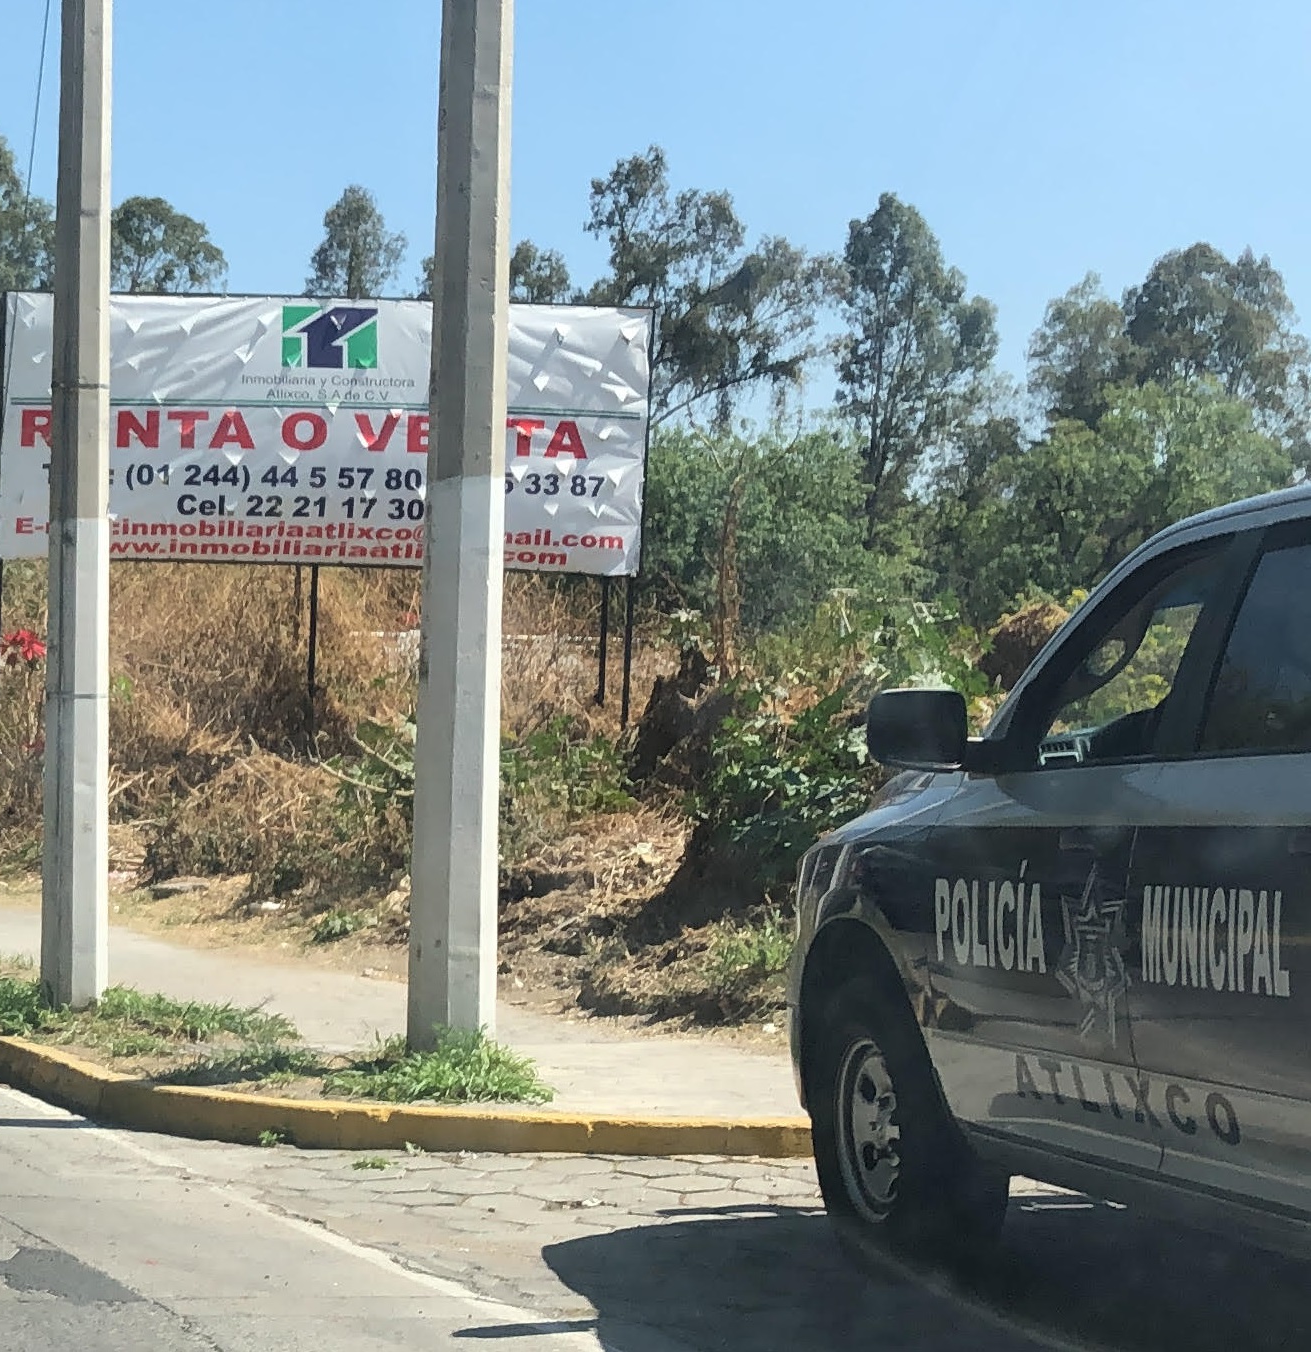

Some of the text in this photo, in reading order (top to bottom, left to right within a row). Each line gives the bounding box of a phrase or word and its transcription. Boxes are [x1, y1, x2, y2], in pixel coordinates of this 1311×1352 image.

[241, 374, 415, 388] Inmobiliaria y Constructora
[20, 409, 588, 459] RNTA O VETA
[125, 464, 170, 490] (01
[184, 464, 250, 492] 244)
[260, 465, 298, 488] 44
[309, 466, 327, 488] 5
[338, 467, 375, 490] 57
[384, 468, 422, 491] 80
[525, 473, 559, 496] 33
[570, 474, 605, 497] 87
[246, 494, 283, 518] 22
[292, 496, 326, 518] 21
[342, 496, 378, 519] 17
[387, 497, 424, 520] 30
[935, 858, 1291, 998] POLICÍA MUNICIPAL
[1014, 1053, 1242, 1146] ATLIXCO
